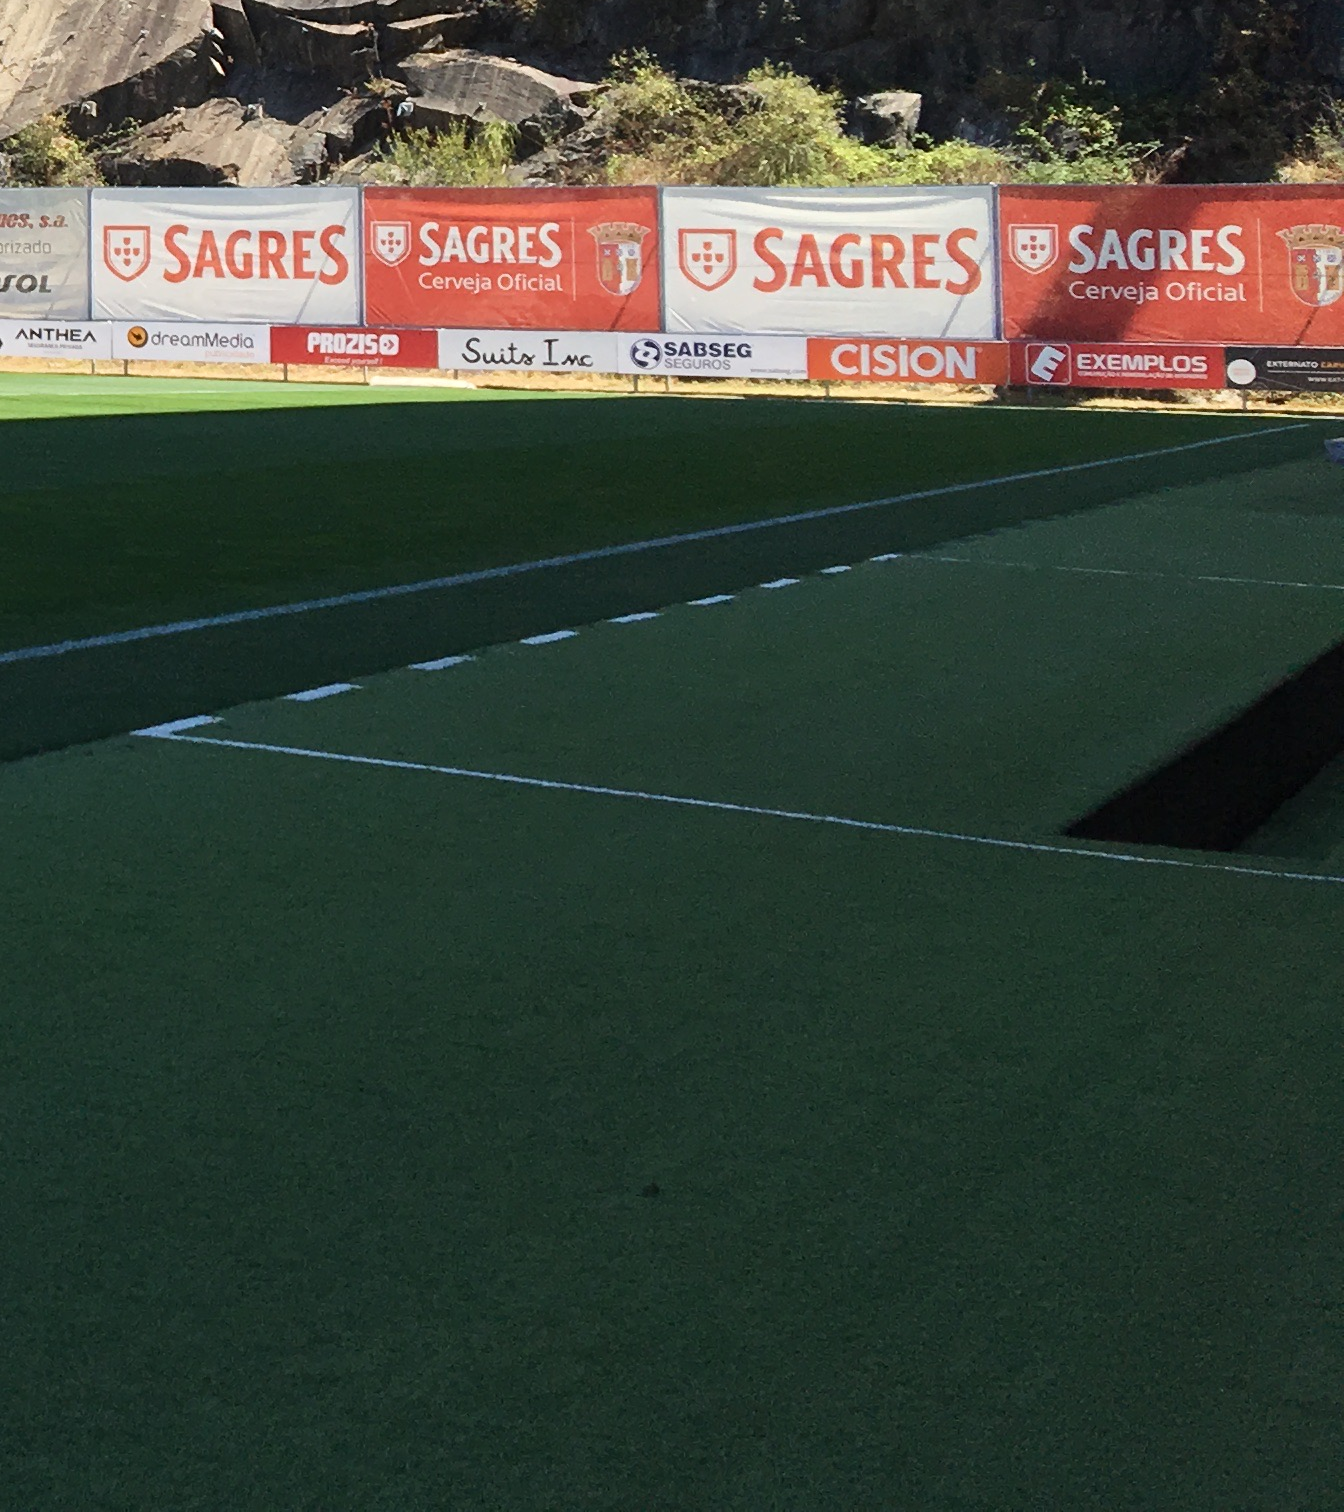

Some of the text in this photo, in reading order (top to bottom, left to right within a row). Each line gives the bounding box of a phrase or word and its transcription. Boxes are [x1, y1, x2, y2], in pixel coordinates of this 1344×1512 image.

[38, 213, 69, 228] s.a.
[162, 224, 349, 285] SAGRES
[418, 221, 563, 268] SAGRES
[1068, 224, 1246, 276] SAGRES
[752, 227, 982, 296] SAGRES
[418, 272, 564, 294] Cerveja Oficial
[1068, 281, 1247, 305] Cerveja Oficial
[15, 328, 98, 343] ANTHEA
[150, 331, 254, 349] dreamMedia
[307, 332, 378, 355] PROZIS
[462, 337, 594, 367] Suits Inc
[664, 342, 753, 358] SABSEG
[830, 343, 977, 380] CISION
[664, 358, 731, 370] SEGUROS
[1076, 354, 1208, 373] EXEMPLOS
